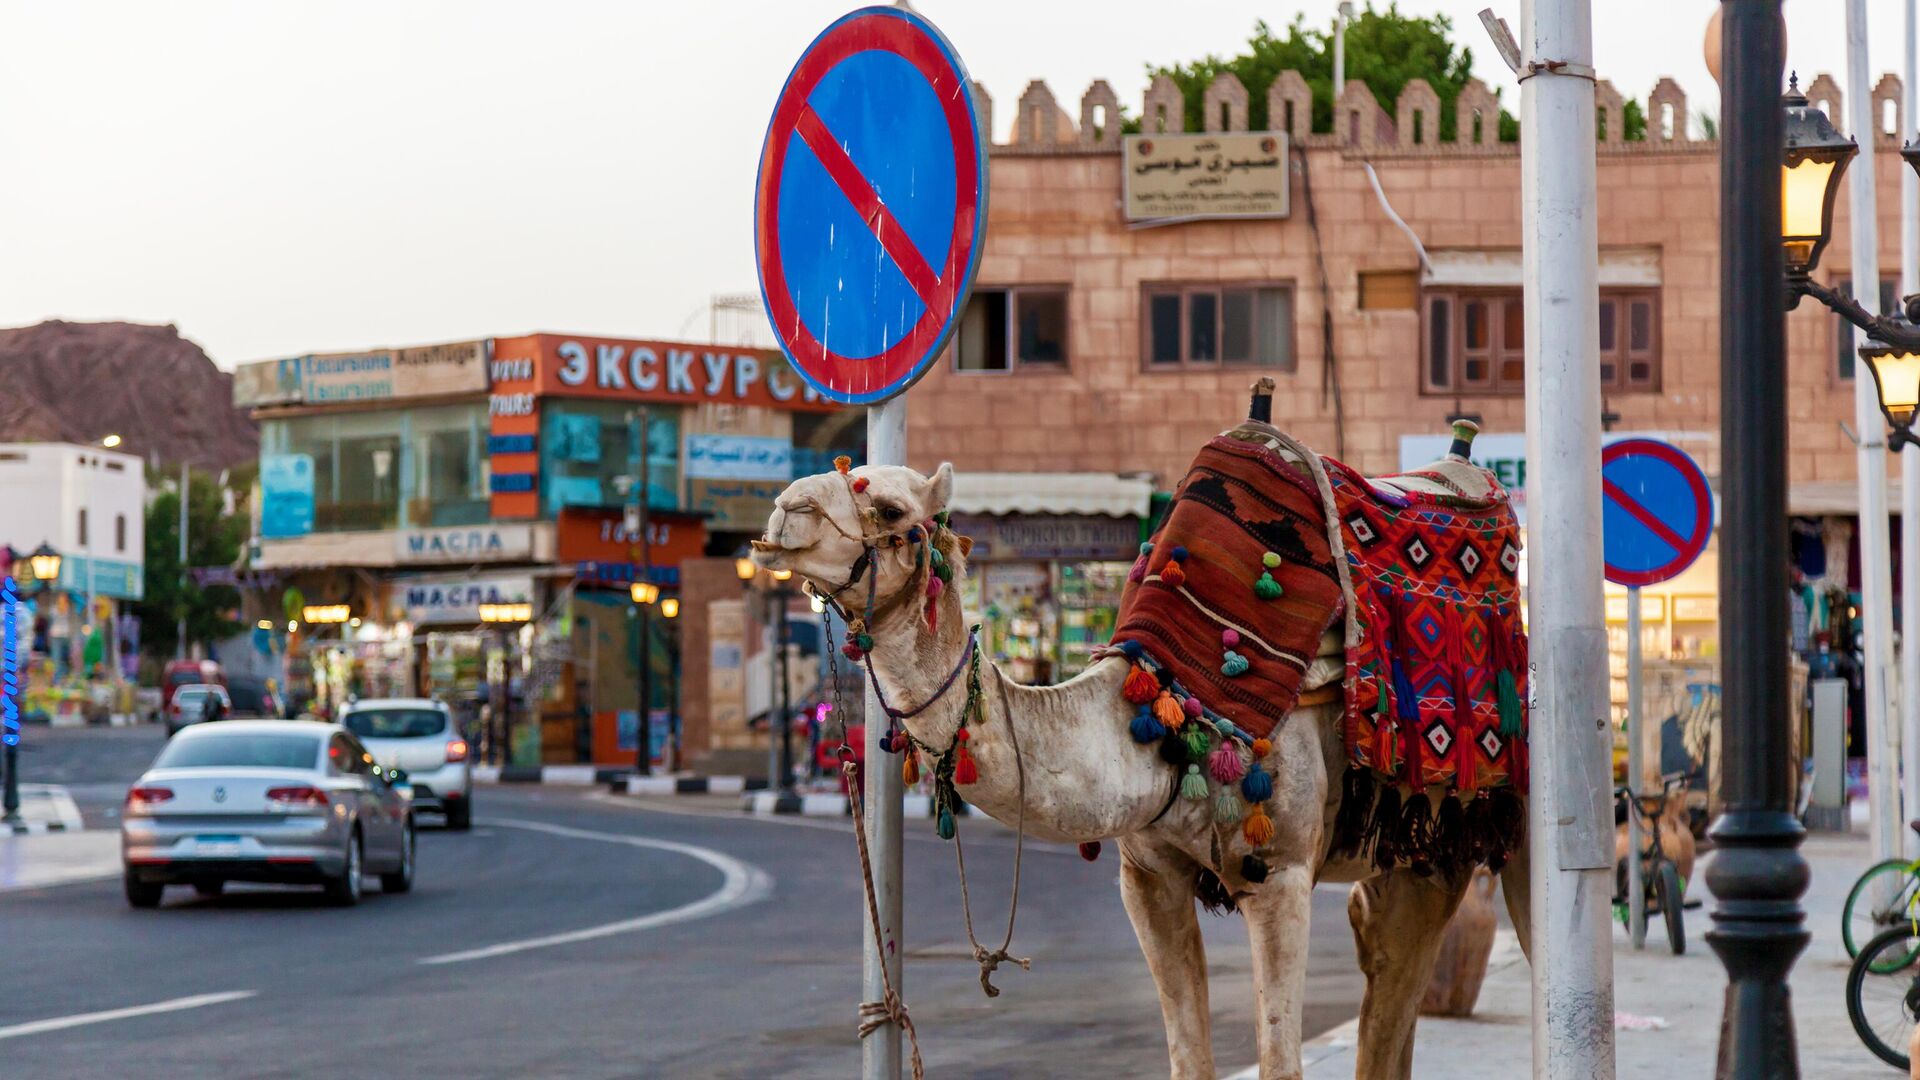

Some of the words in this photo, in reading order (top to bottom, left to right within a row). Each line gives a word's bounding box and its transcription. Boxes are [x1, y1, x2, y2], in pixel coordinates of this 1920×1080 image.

[558, 340, 833, 404] ЭКСКУРС
[489, 393, 535, 416] TOURS
[408, 530, 502, 553] МАСЛА
[407, 584, 501, 607] МАСЛА
